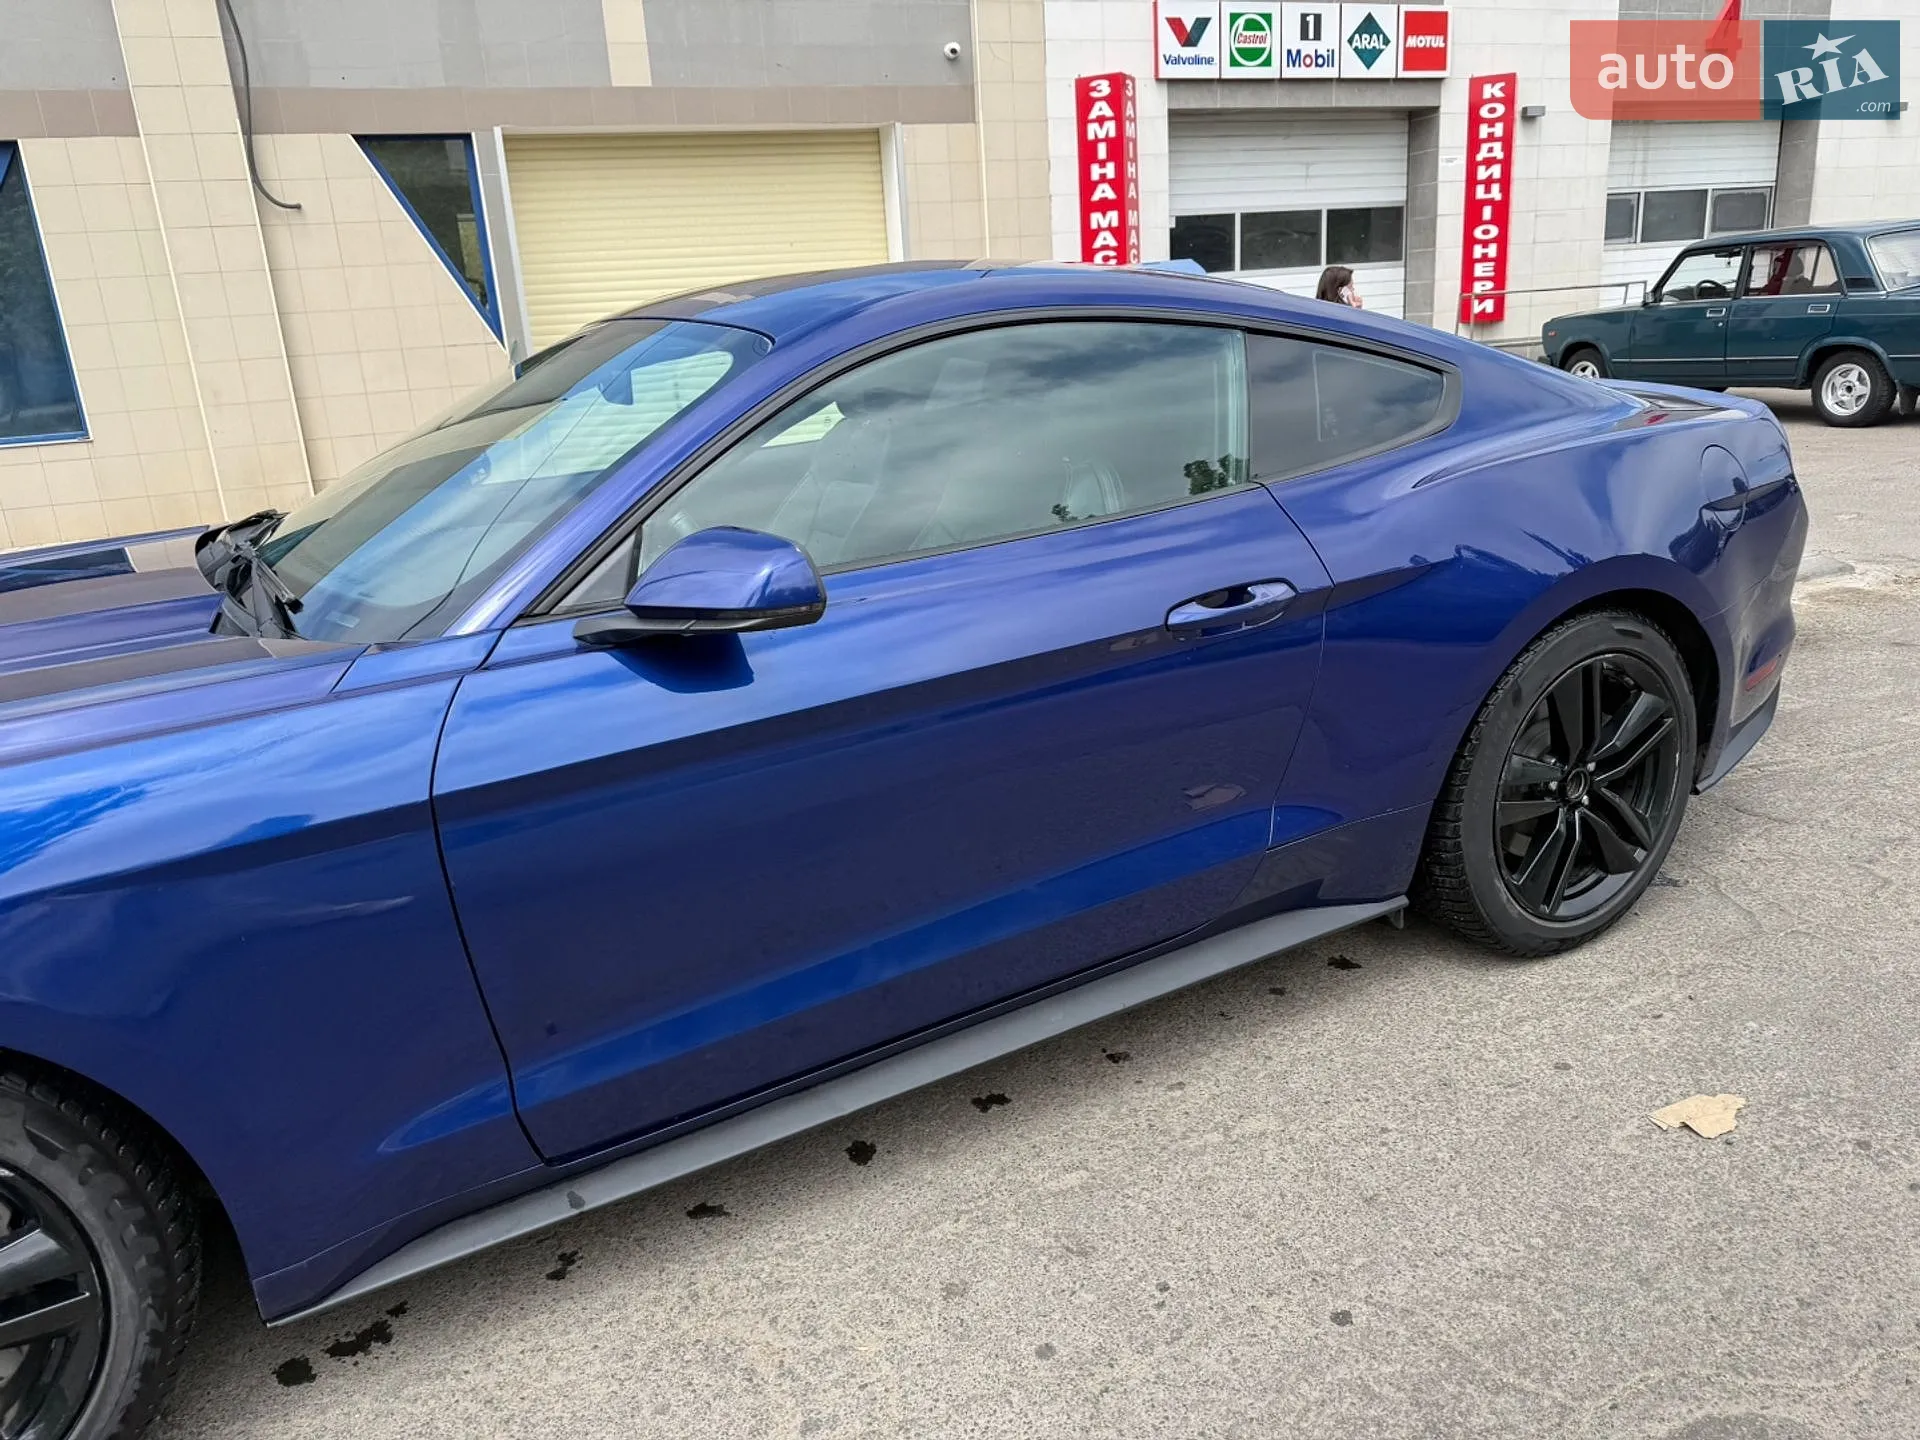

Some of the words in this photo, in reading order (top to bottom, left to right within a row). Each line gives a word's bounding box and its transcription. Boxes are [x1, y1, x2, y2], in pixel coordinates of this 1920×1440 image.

[1236, 33, 1268, 45] Castrol
[1350, 34, 1387, 50] ARAL
[1405, 36, 1446, 48] MOTUL
[1163, 54, 1215, 66] Valvoline
[1286, 48, 1335, 68] Mobil
[1087, 79, 1117, 202] ЗАМІНА
[1472, 81, 1506, 315] КОНДИЦІОНЕРИ
